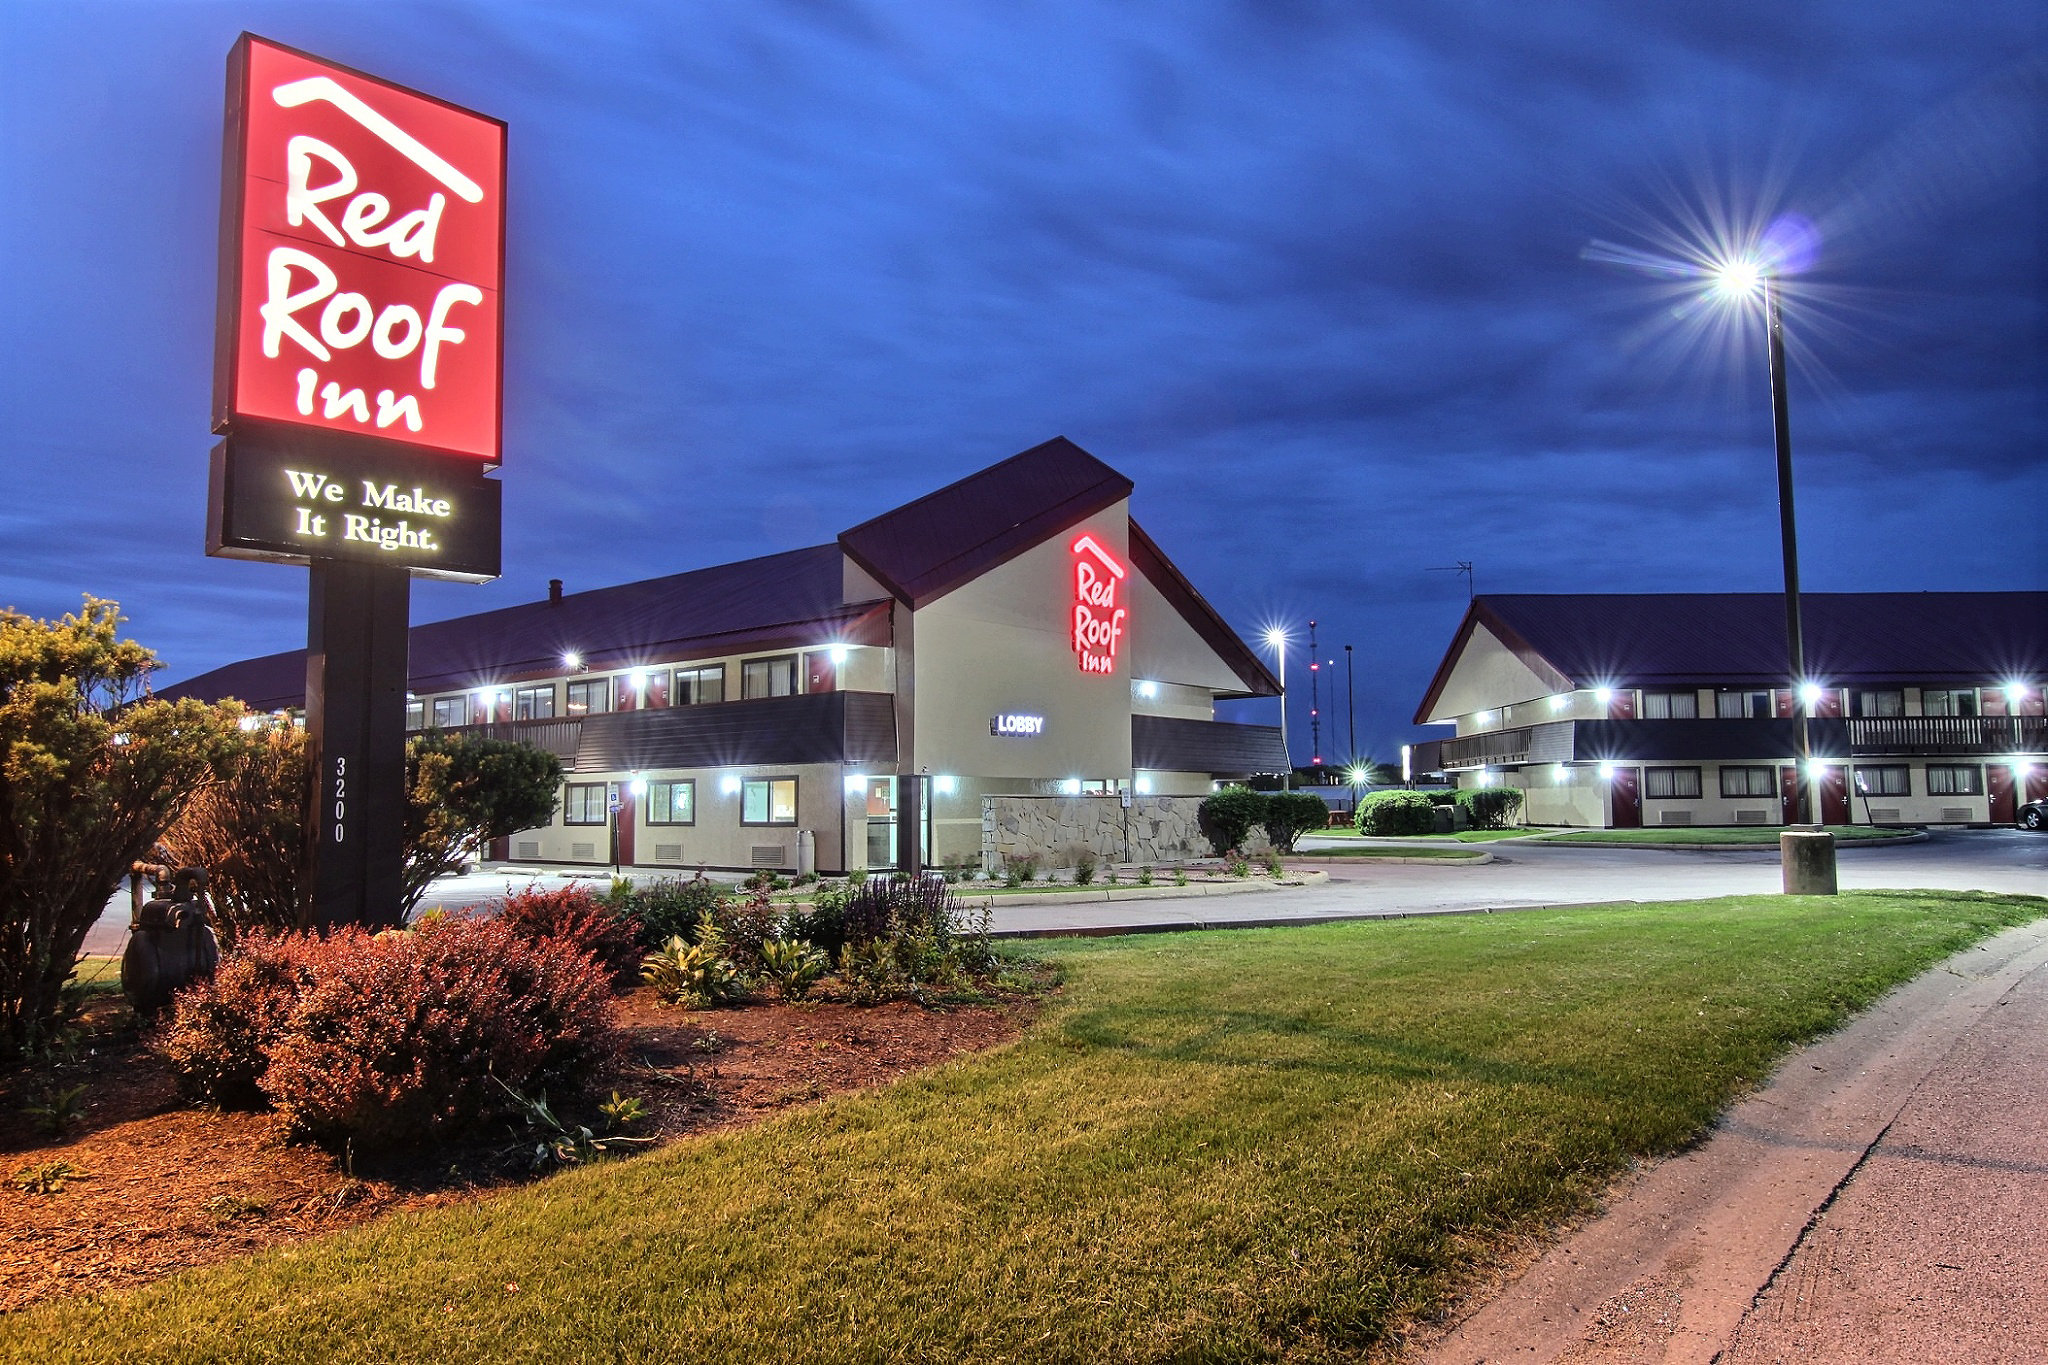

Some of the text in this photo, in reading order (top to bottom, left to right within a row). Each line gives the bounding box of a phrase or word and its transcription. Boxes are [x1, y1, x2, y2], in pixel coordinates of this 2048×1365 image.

[286, 134, 446, 264] Red
[260, 246, 483, 390] Roof
[284, 469, 451, 517] We Make
[296, 507, 439, 551] It Right.
[1077, 561, 1116, 608] Red
[1074, 604, 1125, 657] Roof
[997, 714, 1044, 734] LOBBY
[335, 756, 346, 843] 3200
